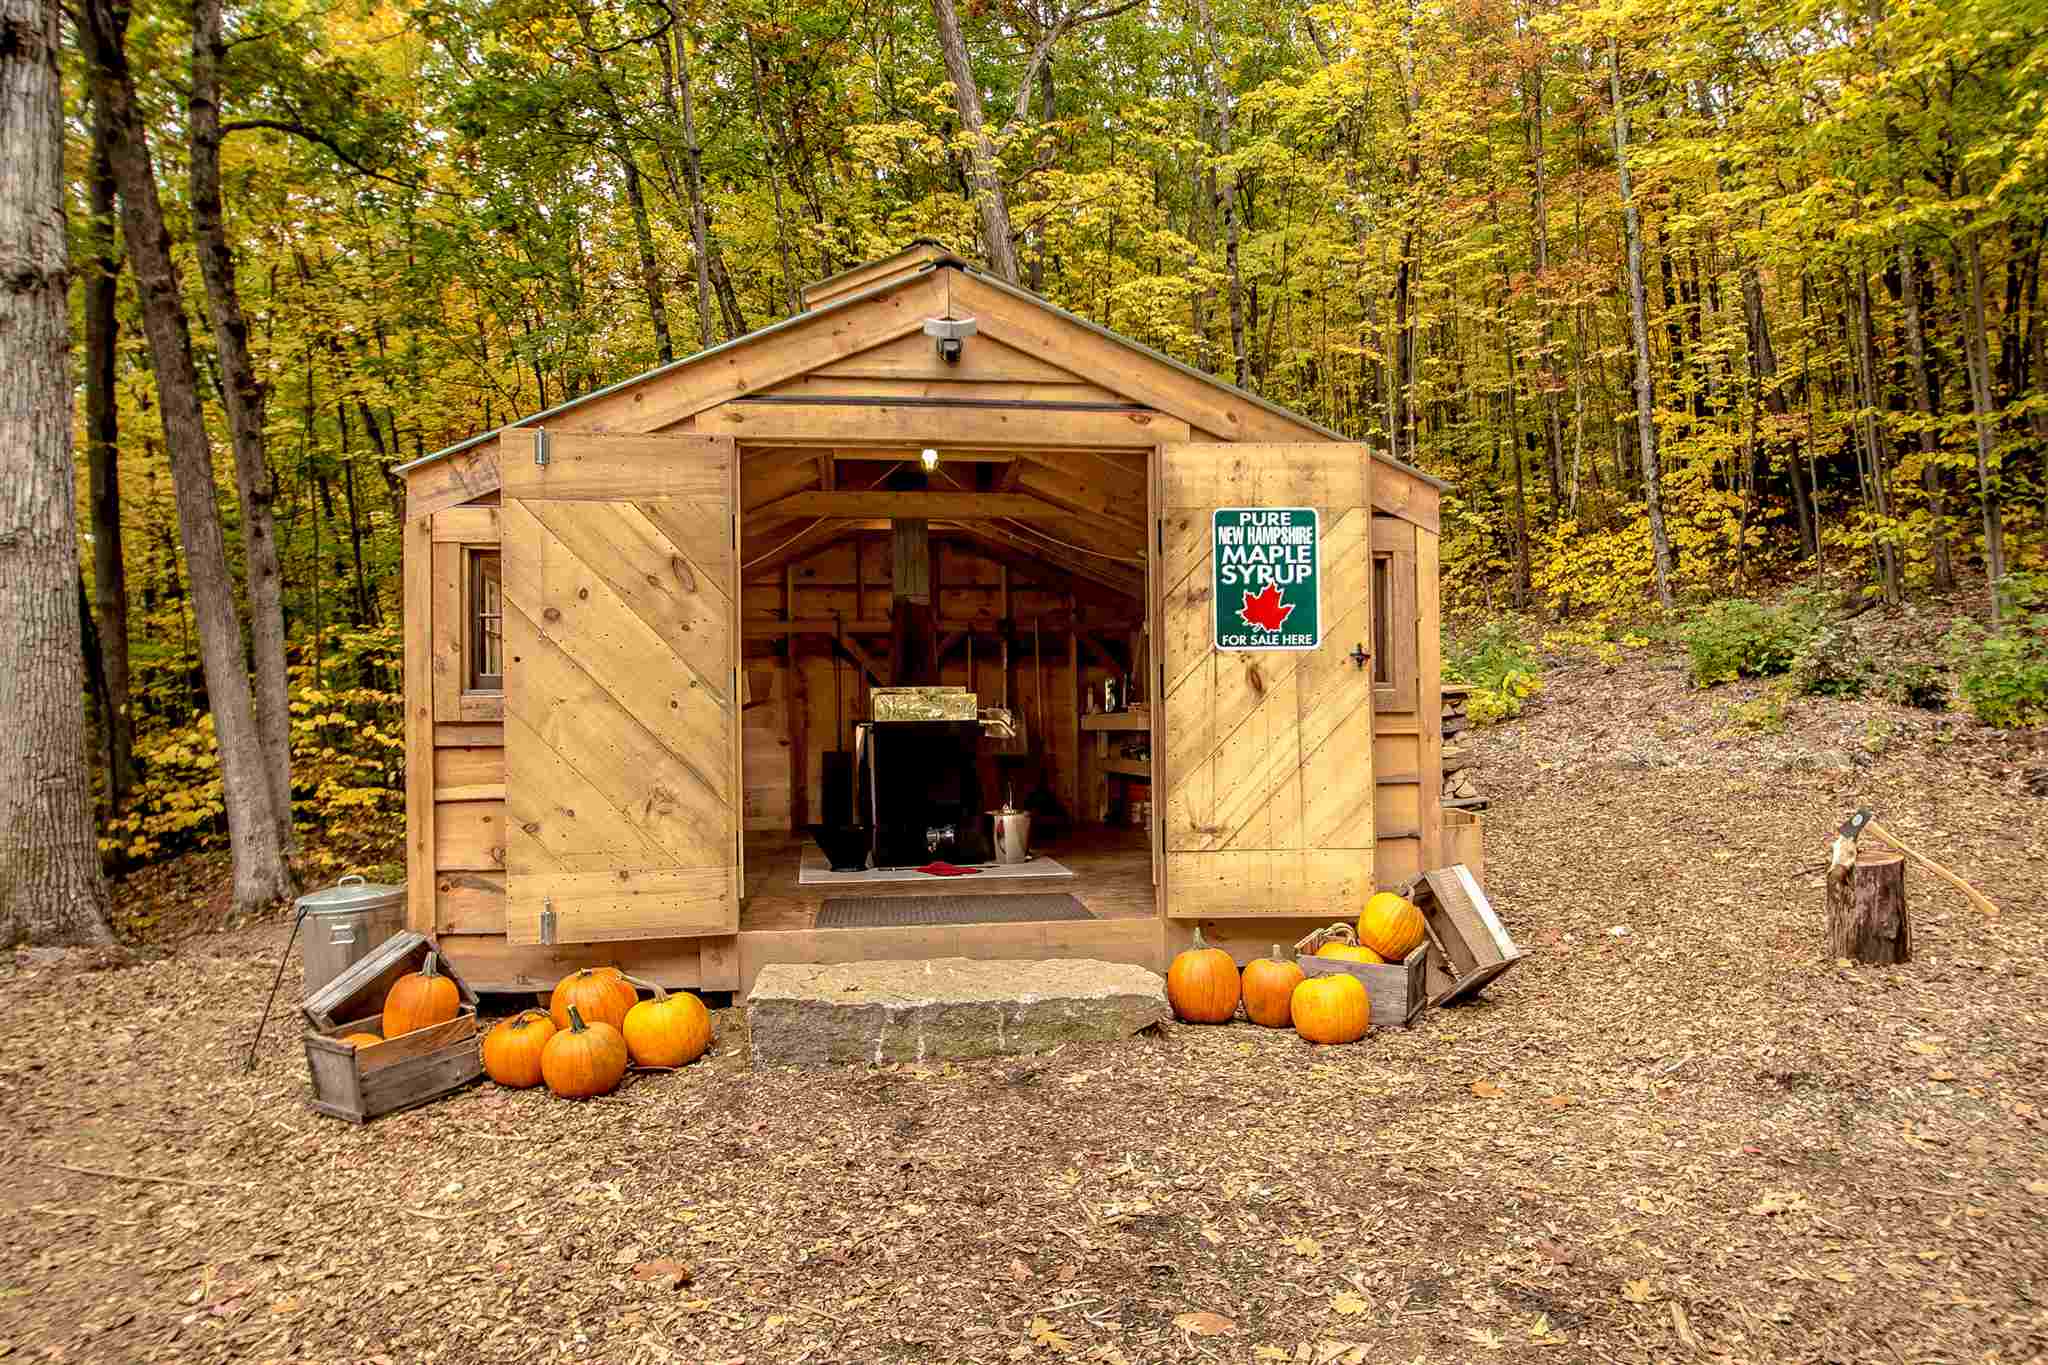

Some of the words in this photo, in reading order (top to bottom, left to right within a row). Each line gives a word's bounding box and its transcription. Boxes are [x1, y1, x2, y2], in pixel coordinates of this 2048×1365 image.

[1239, 512, 1291, 526] PURE
[1218, 526, 1244, 544] NEW
[1247, 526, 1313, 544] HAMPSHIRE
[1221, 545, 1312, 564] MAPLE
[1221, 565, 1312, 584] SYRUP
[1222, 634, 1247, 645] FOR
[1251, 634, 1279, 645] SALE
[1282, 634, 1312, 645] HERE
